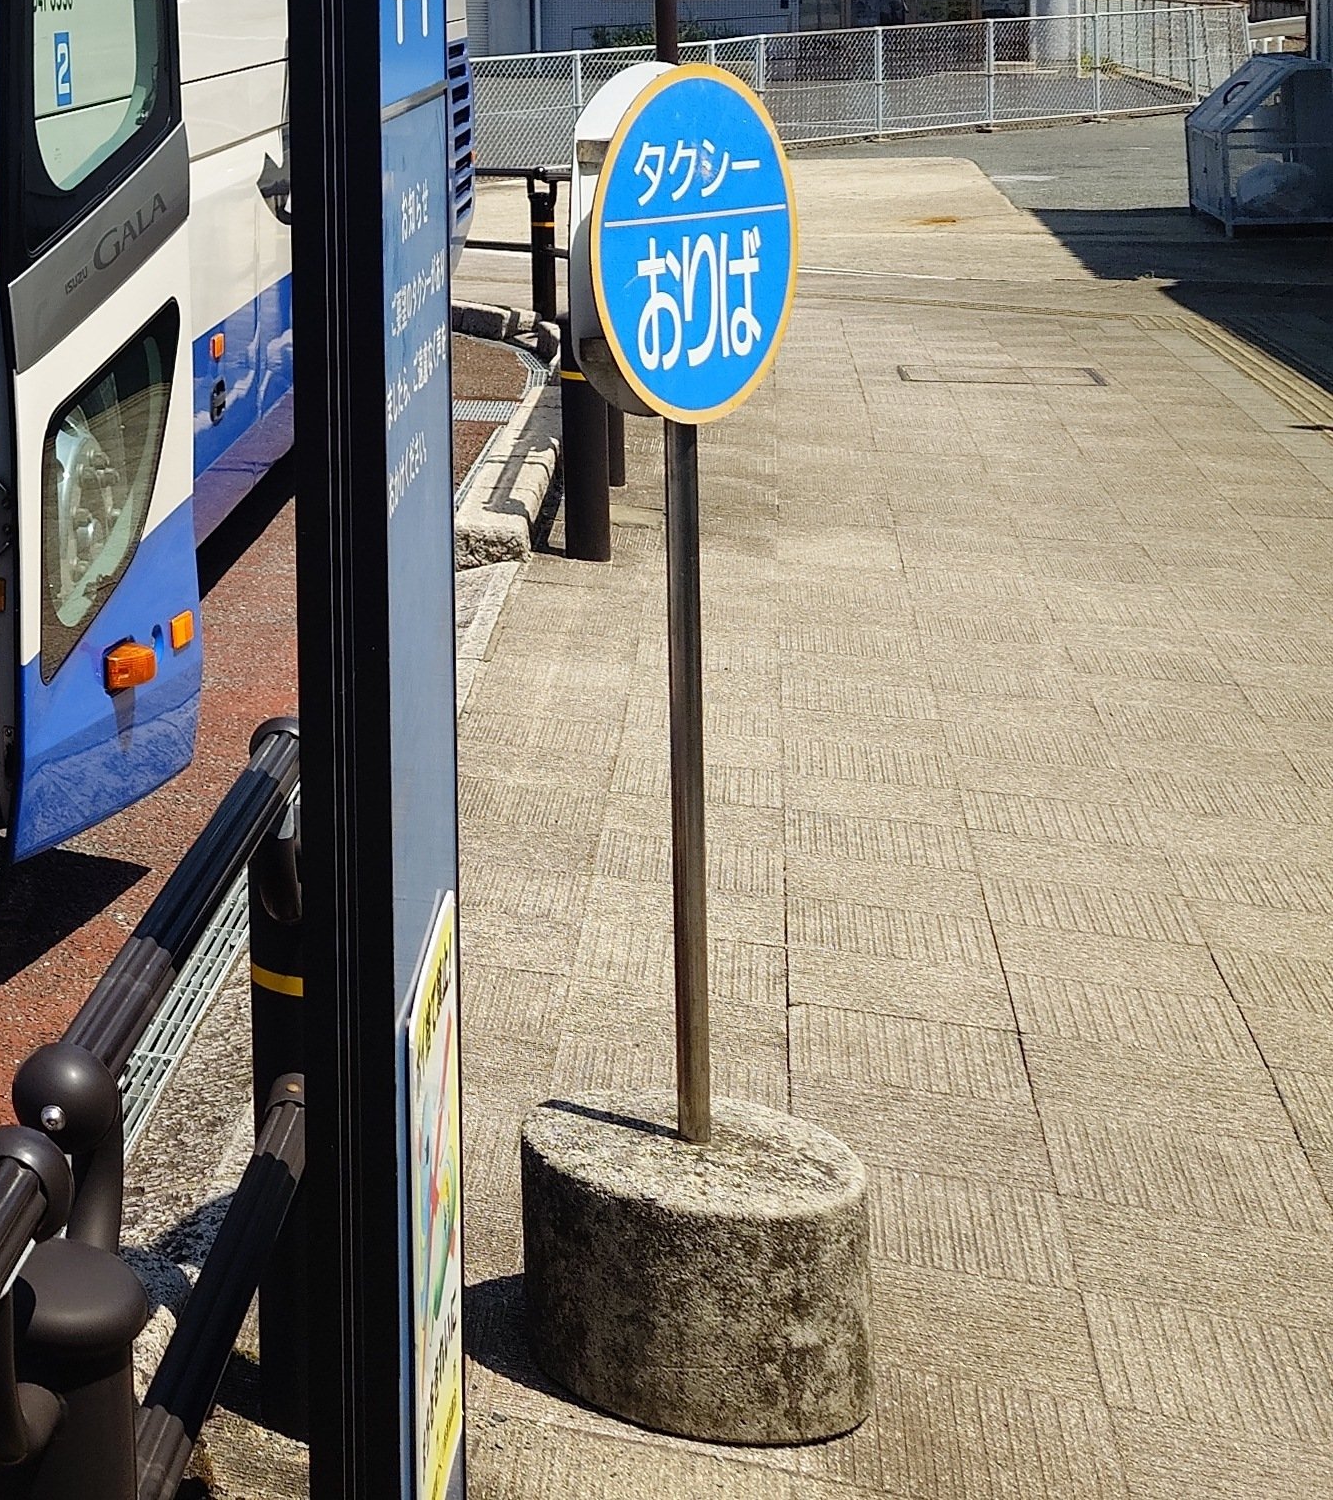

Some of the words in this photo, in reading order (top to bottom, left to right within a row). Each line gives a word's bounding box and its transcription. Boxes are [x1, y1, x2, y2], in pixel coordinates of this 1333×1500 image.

[56, 42, 70, 95] 2
[633, 138, 761, 207] タクシー
[64, 266, 89, 295] ISUZU
[93, 192, 167, 271] GALA
[401, 178, 429, 244] お知らせ
[637, 225, 762, 372] おりば
